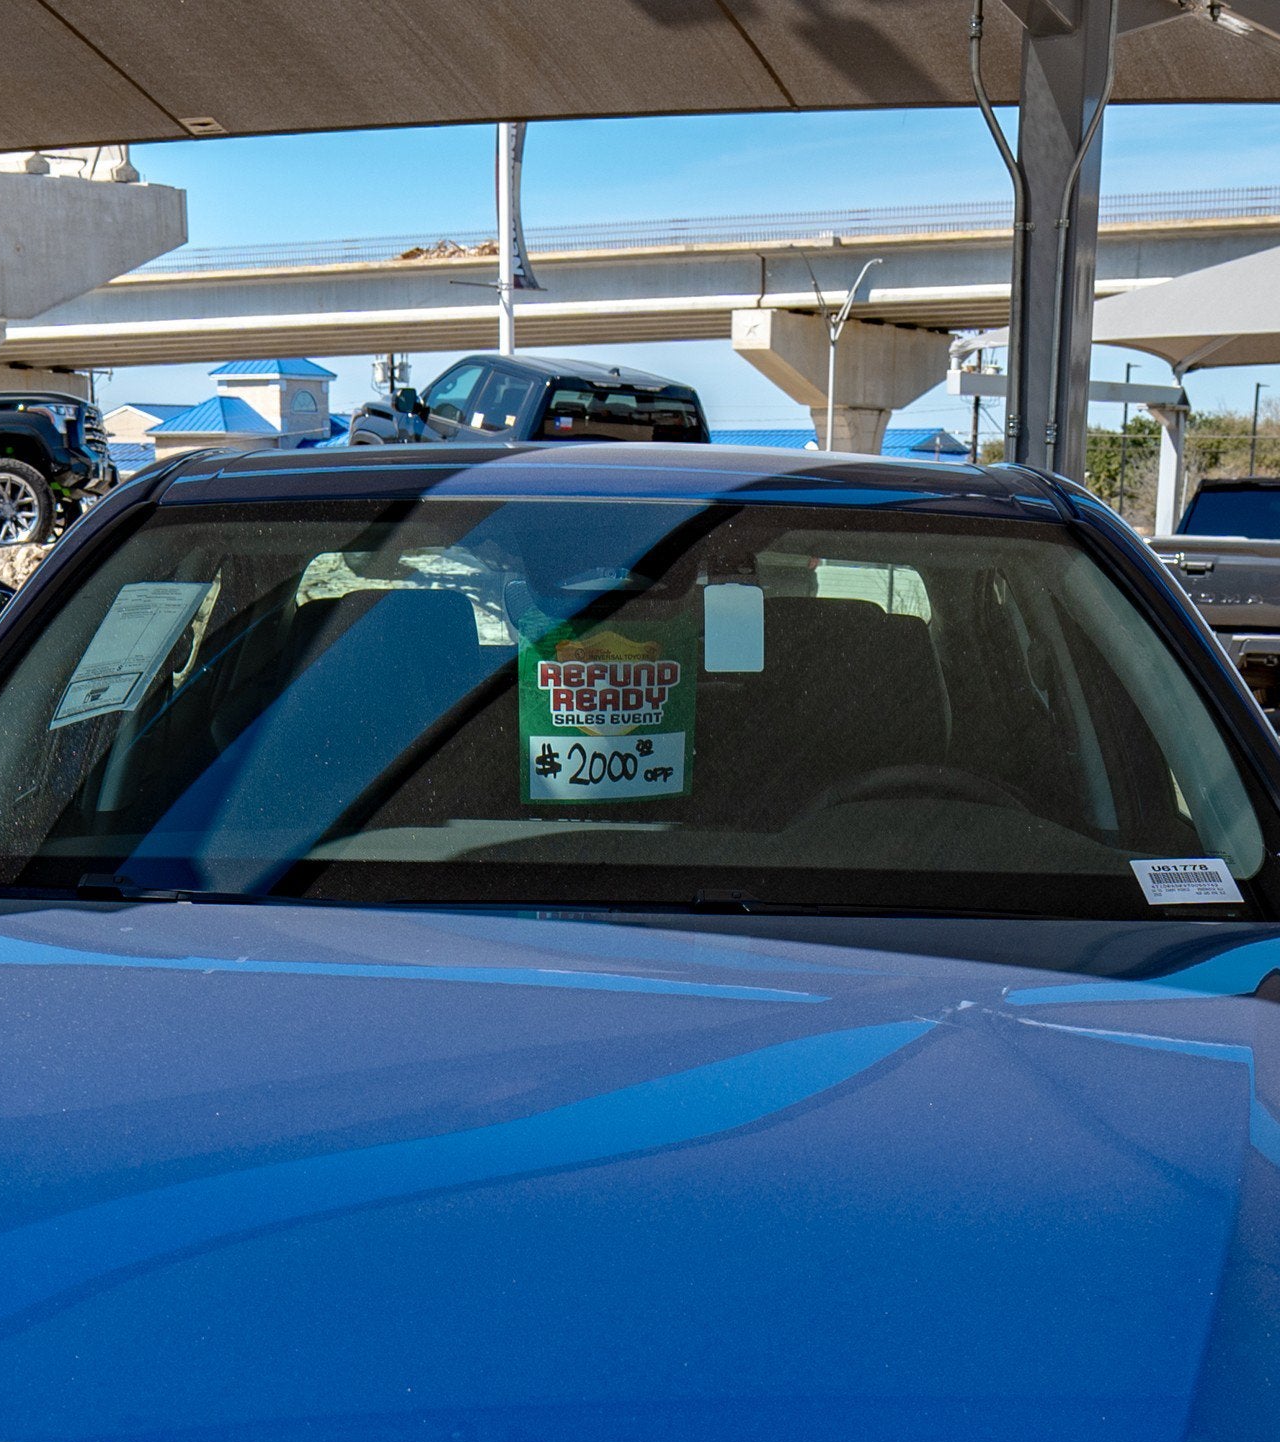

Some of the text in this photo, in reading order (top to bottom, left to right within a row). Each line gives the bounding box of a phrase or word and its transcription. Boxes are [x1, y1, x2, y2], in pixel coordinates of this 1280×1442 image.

[540, 663, 679, 688] REFUND
[552, 687, 667, 711] READY
[554, 712, 662, 725] SALES EVENT
[643, 767, 674, 783] OFF
[1151, 864, 1209, 872] U61778
